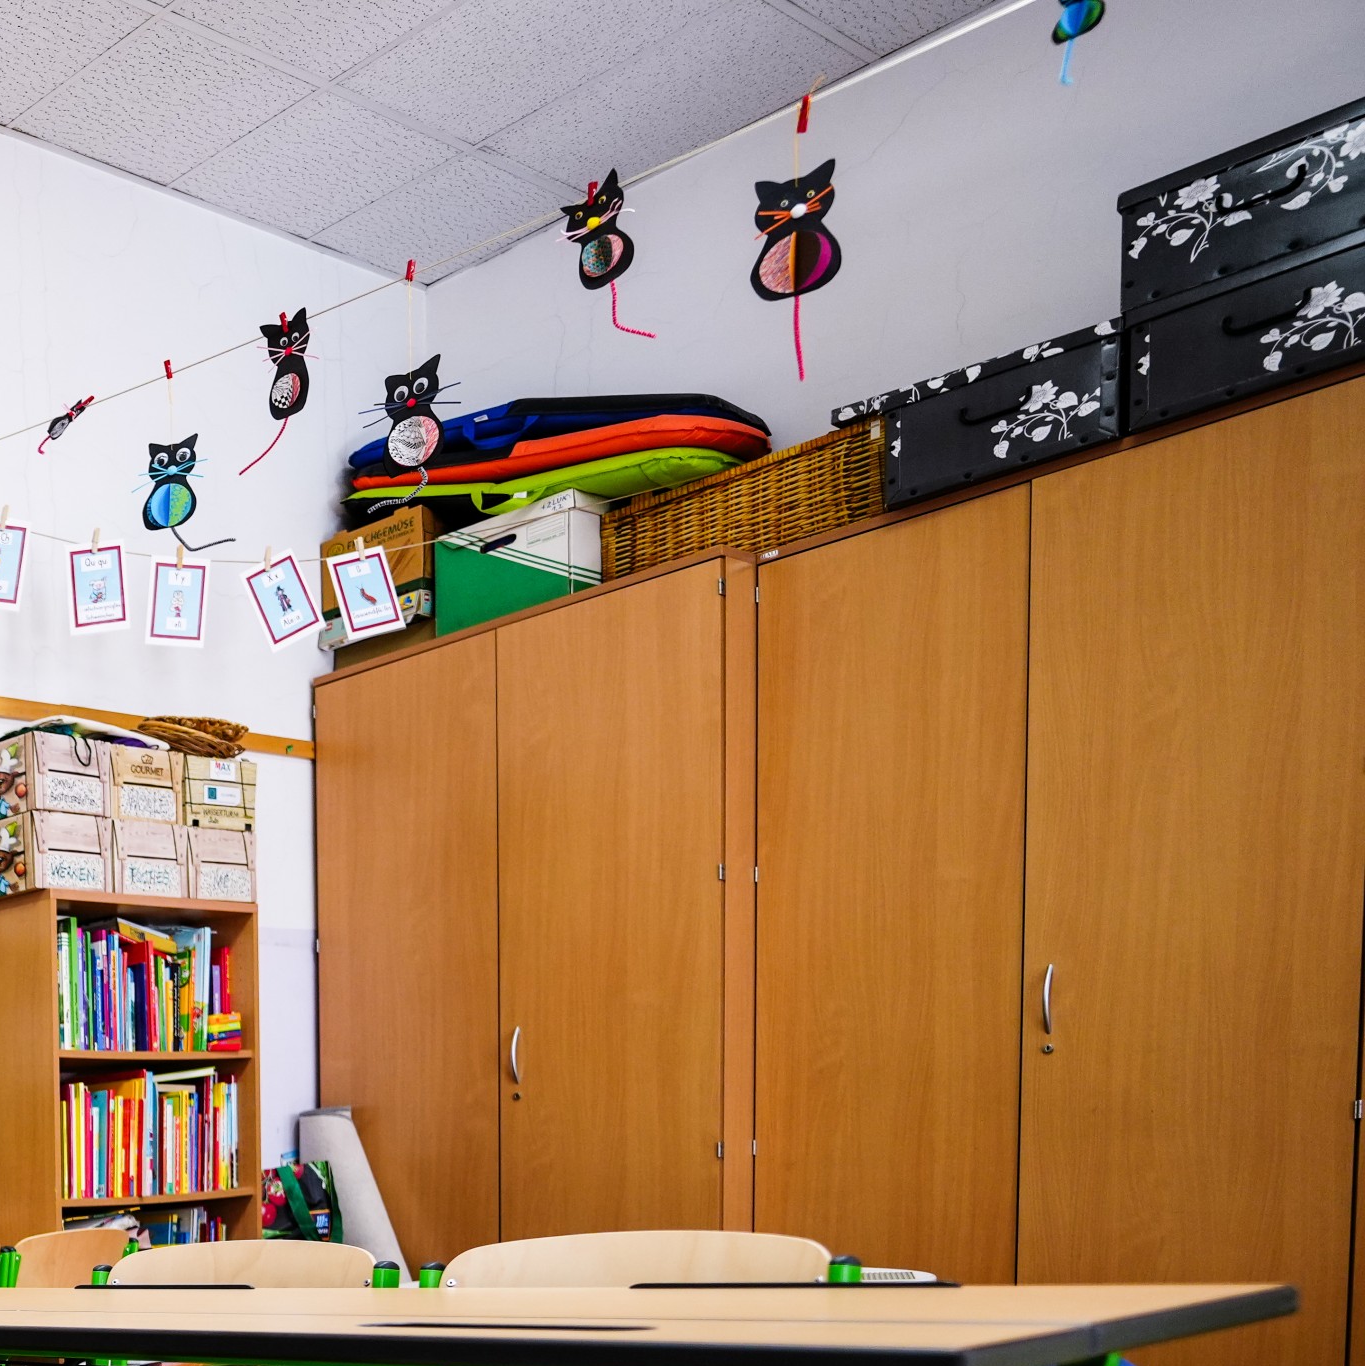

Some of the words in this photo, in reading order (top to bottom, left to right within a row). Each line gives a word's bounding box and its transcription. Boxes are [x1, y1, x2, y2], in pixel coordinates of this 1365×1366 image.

[283, 615, 301, 627] Alea
[131, 765, 164, 776] GOURMET
[215, 761, 231, 772] MAX
